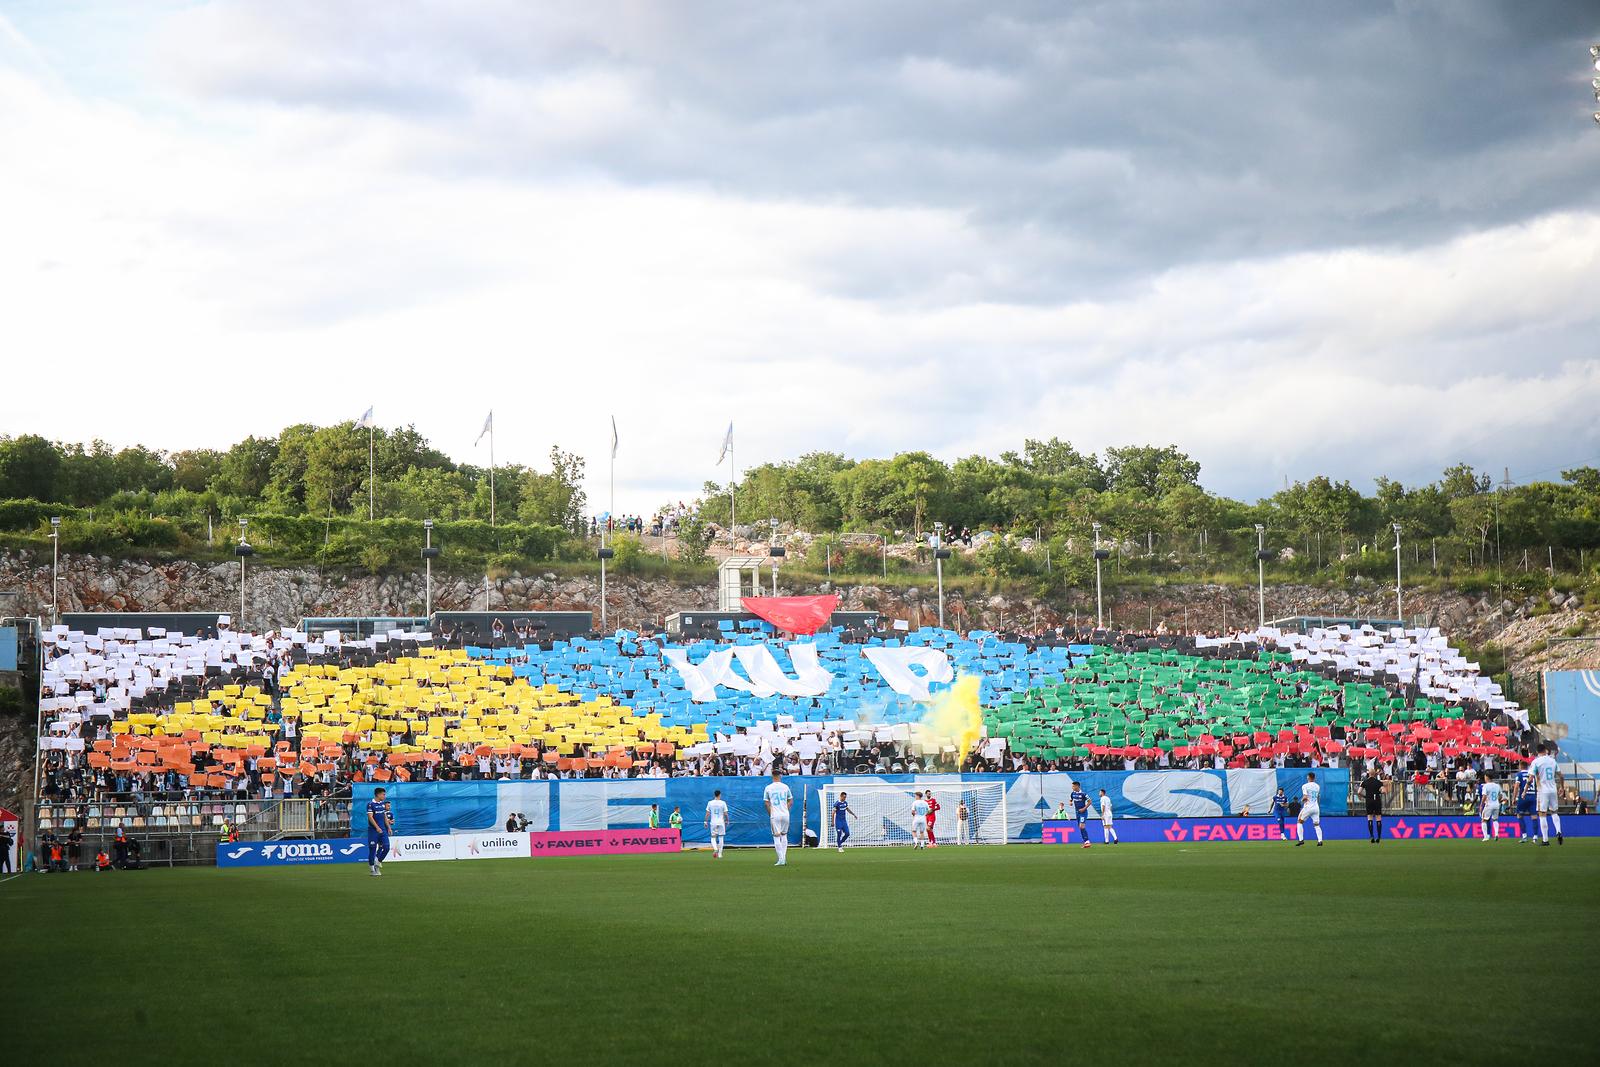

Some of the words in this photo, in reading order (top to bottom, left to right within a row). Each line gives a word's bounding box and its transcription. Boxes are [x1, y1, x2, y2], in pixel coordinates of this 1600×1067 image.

[1545, 767, 1553, 780] 6
[771, 791, 787, 806] 34
[1491, 791, 1498, 802] 8
[404, 839, 441, 850] uniline
[482, 837, 518, 848] uniline
[547, 839, 604, 848] FAVBET
[622, 836, 678, 846] FAVBET
